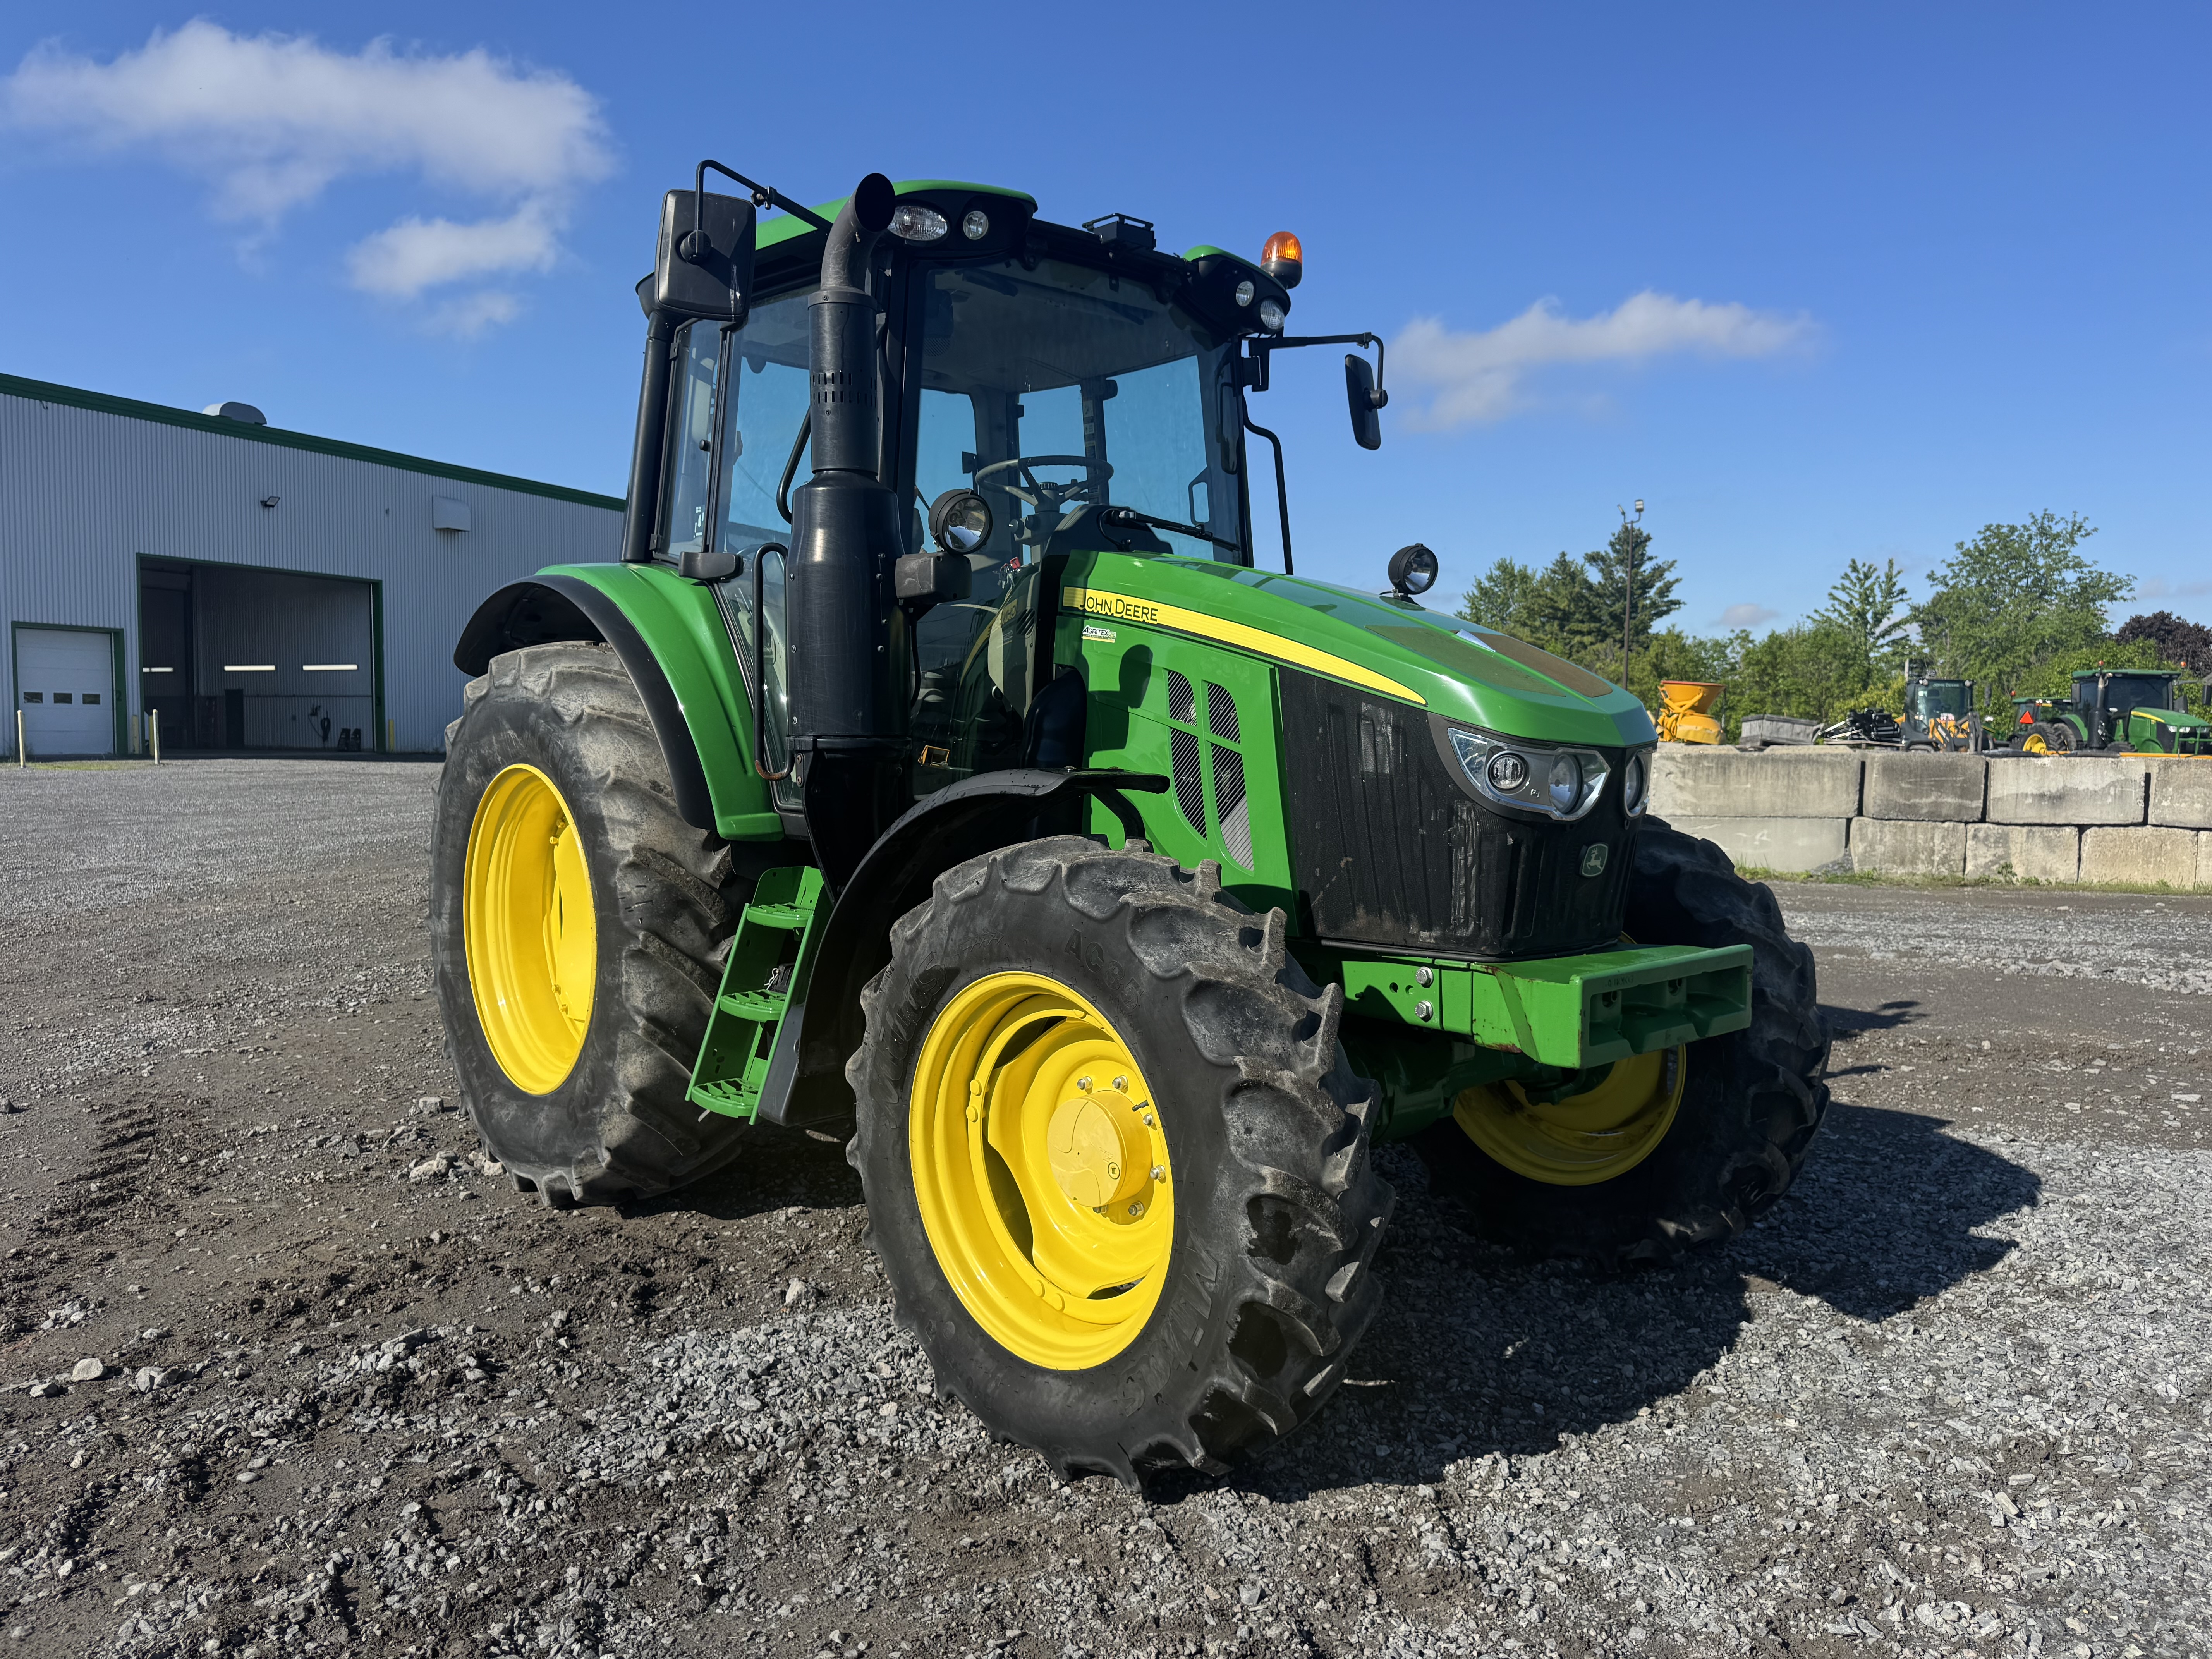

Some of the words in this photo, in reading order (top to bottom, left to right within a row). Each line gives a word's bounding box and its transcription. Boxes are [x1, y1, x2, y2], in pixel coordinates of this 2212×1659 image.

[1079, 592, 1112, 613] JOHN
[1115, 598, 1158, 622] DEERE
[1082, 627, 1108, 636] AGRITEX
